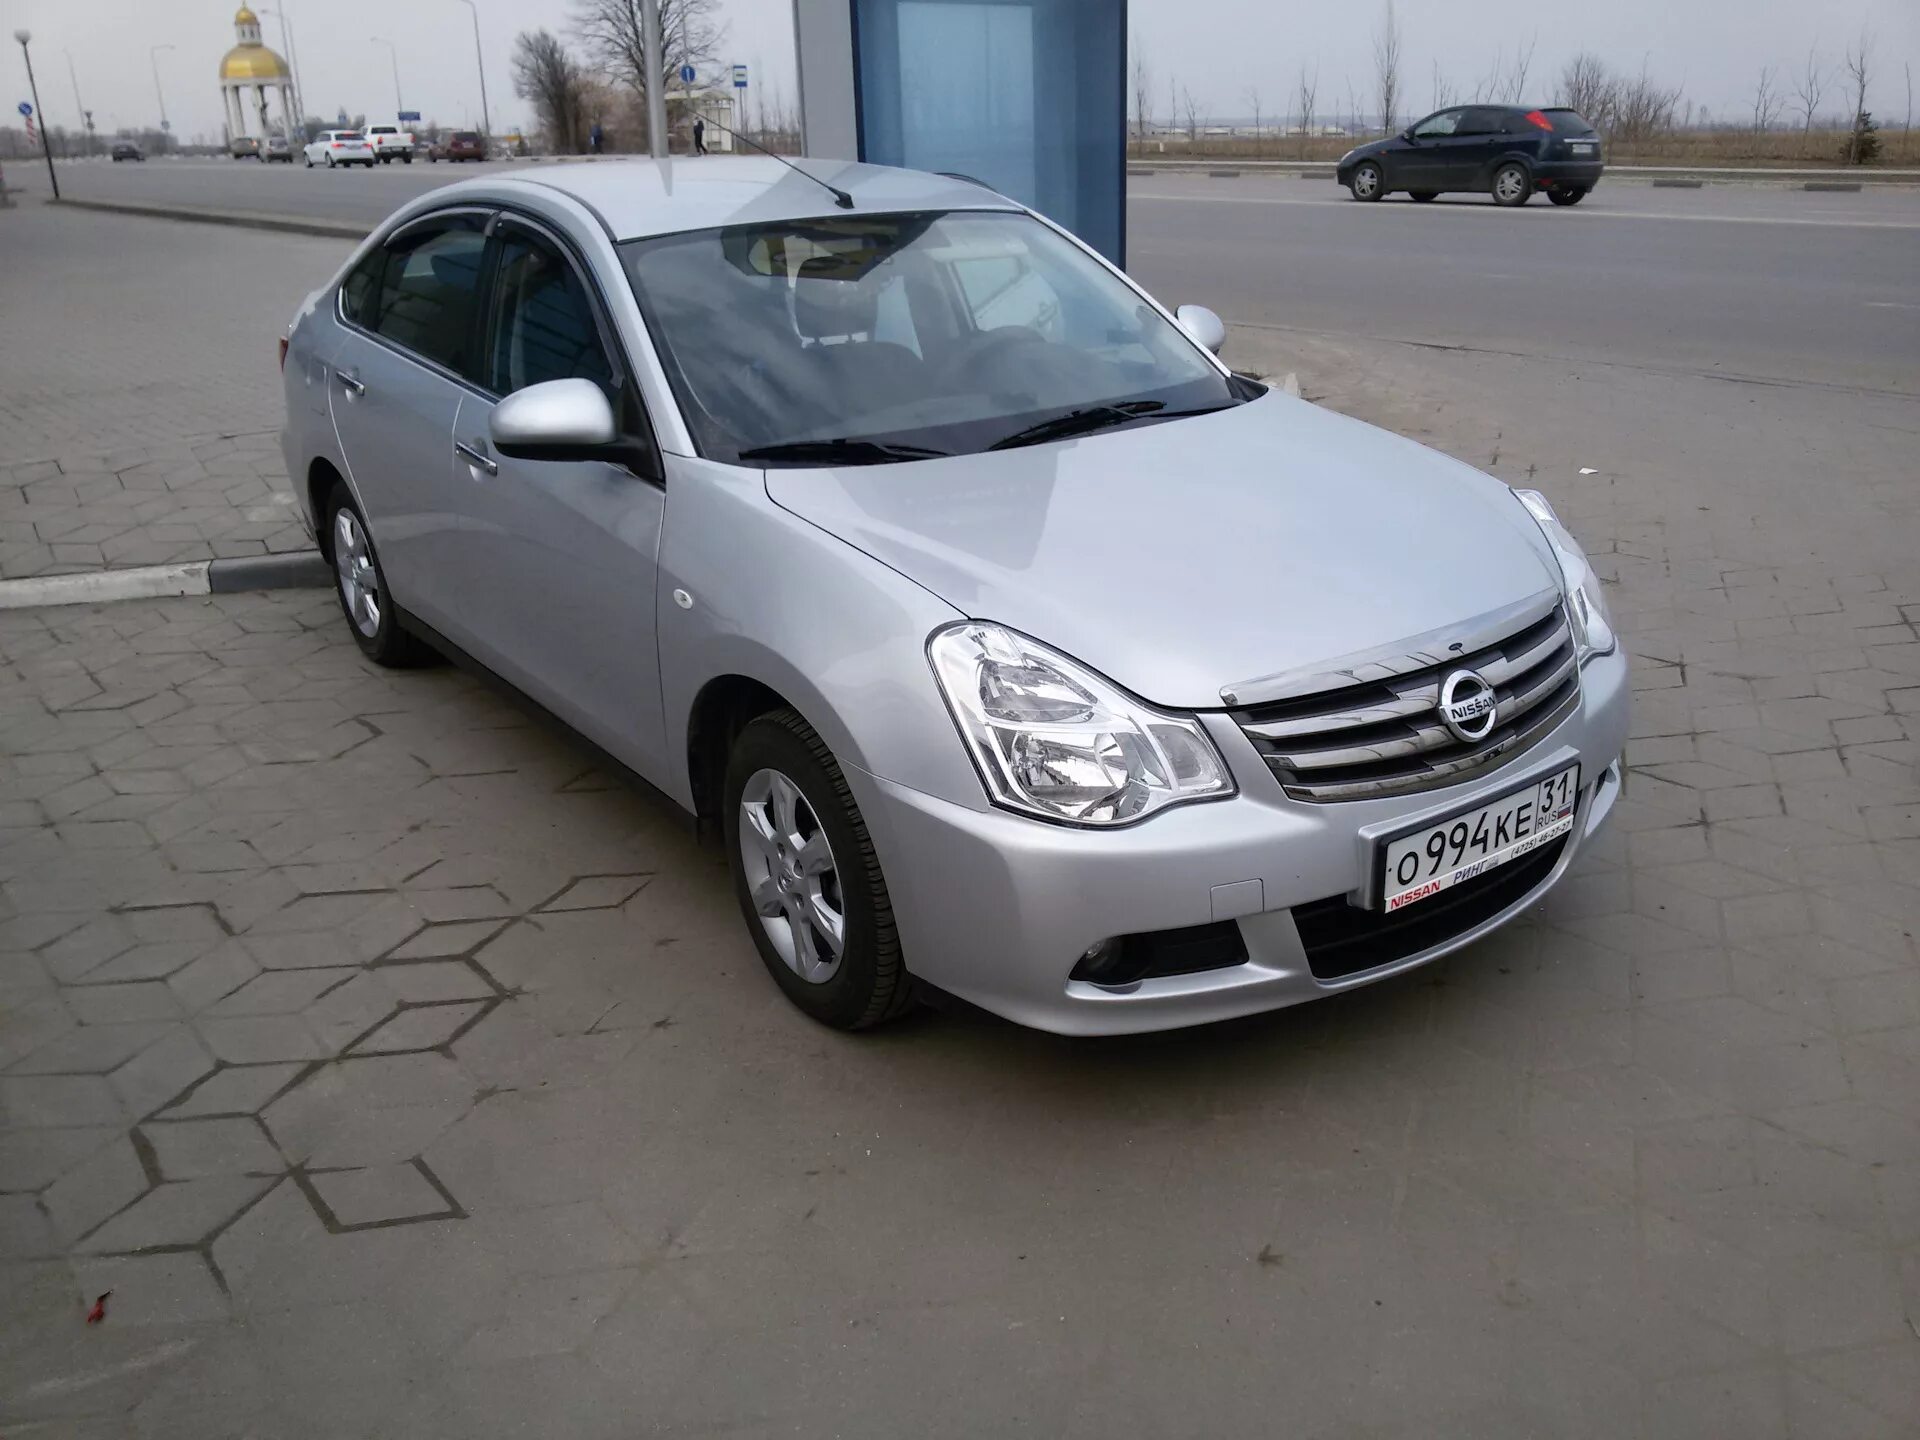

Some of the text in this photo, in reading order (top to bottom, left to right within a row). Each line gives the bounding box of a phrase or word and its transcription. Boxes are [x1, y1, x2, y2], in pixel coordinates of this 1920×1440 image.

[1451, 696, 1496, 719] NISSAN
[1541, 772, 1569, 813] 31
[1537, 810, 1557, 830] RUS
[1511, 839, 1536, 859] (4725)
[1453, 860, 1487, 884] РИНГ
[1390, 880, 1441, 910] NISSAN
